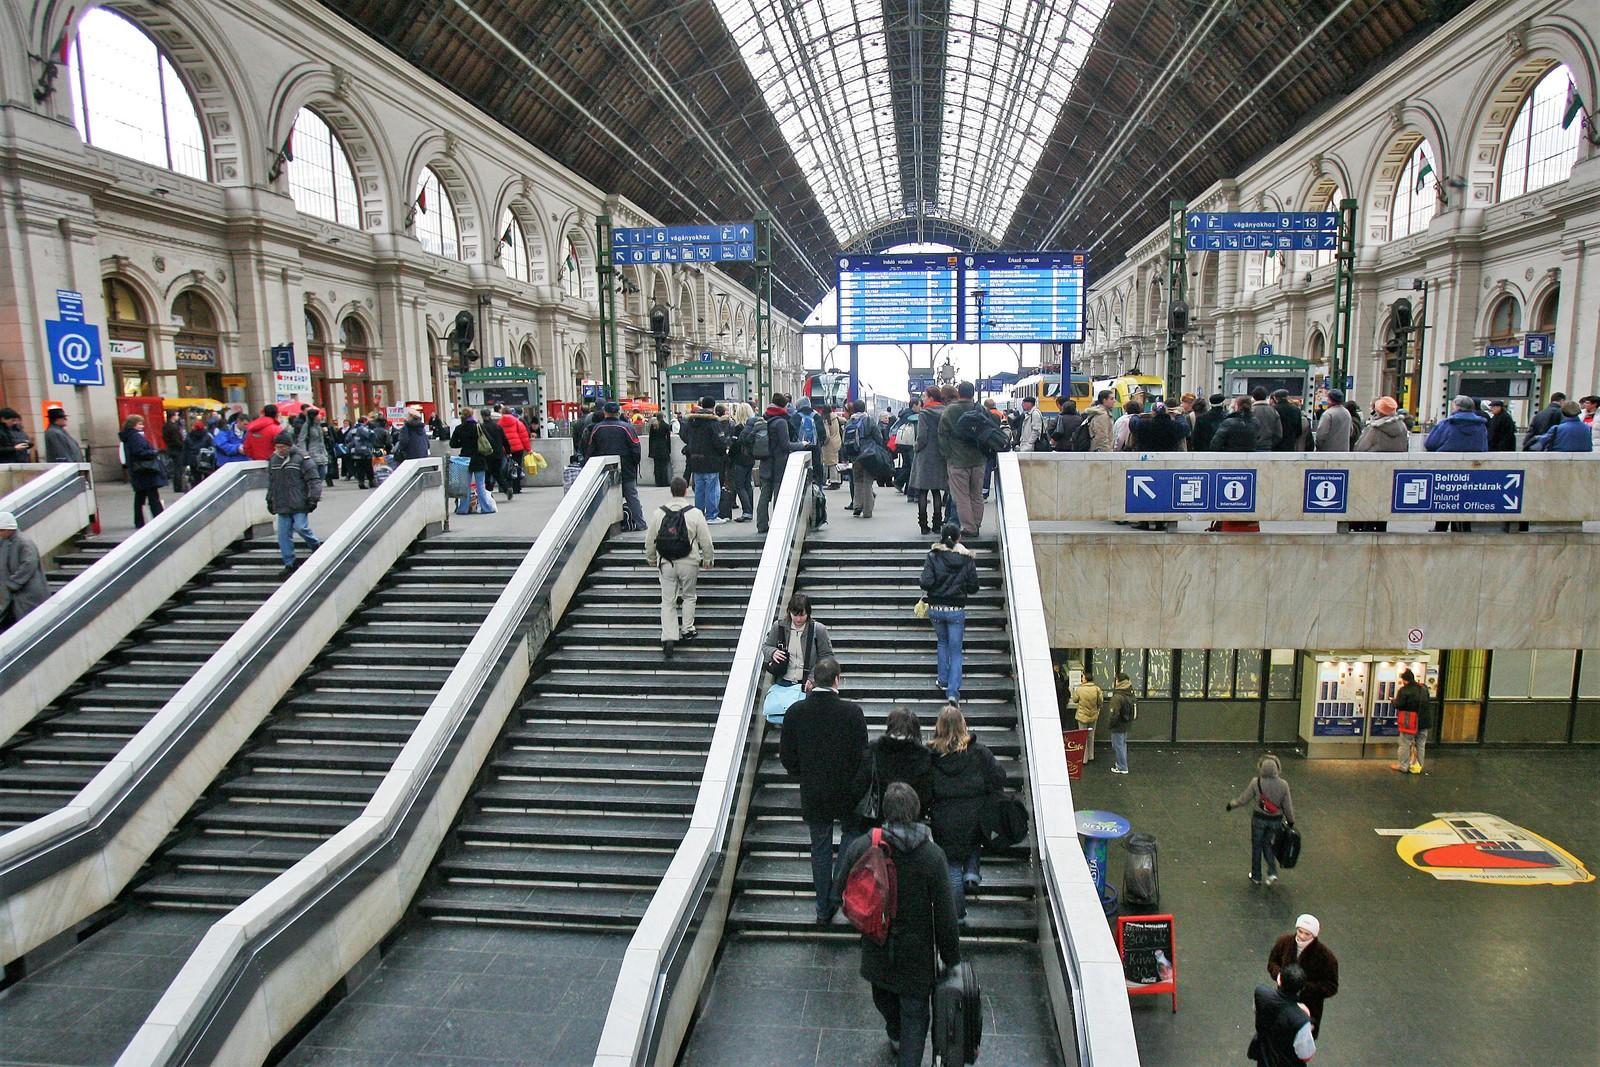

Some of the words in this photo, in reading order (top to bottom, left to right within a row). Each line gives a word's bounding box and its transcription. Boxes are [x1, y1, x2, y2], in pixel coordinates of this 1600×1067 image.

[1282, 217, 1289, 227] 9
[1304, 217, 1317, 227] 13
[634, 233, 640, 242] 1
[657, 232, 664, 242] 6
[670, 234, 710, 242] vágányokhoz
[1263, 347, 1269, 355] 8
[703, 353, 709, 361] 7
[58, 373, 69, 383] 10
[1434, 474, 1470, 482] Belföldi
[1434, 483, 1502, 492] Jegypénztárak
[1433, 493, 1460, 501] Inland
[1433, 502, 1460, 510] Ticket
[1463, 502, 1495, 510] Offices
[1082, 822, 1118, 833] NESTEA
